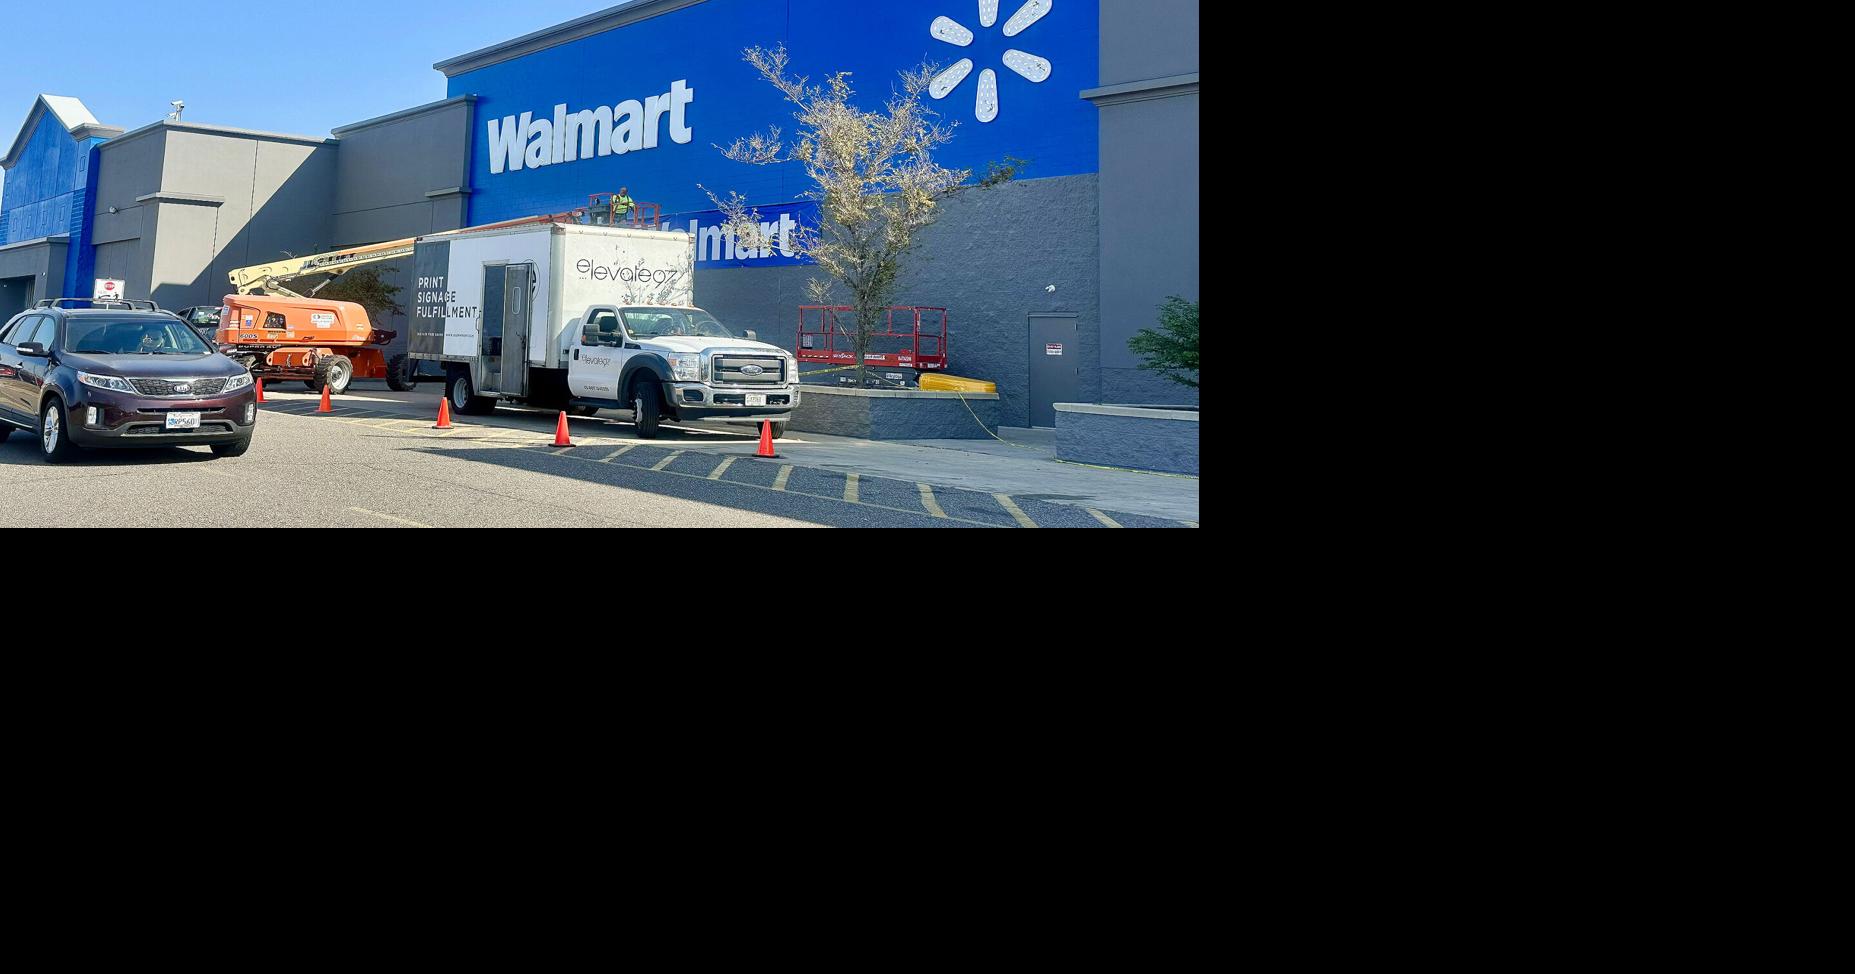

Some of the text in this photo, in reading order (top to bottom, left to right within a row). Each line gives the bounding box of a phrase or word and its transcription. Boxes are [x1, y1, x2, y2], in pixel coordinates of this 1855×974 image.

[487, 79, 693, 174] Walmart
[651, 213, 795, 262] lmrt
[418, 276, 444, 289] PRINT
[577, 259, 678, 289] elevate97
[417, 291, 456, 303] SIGNAGE
[416, 306, 478, 318] FULFILLMENT
